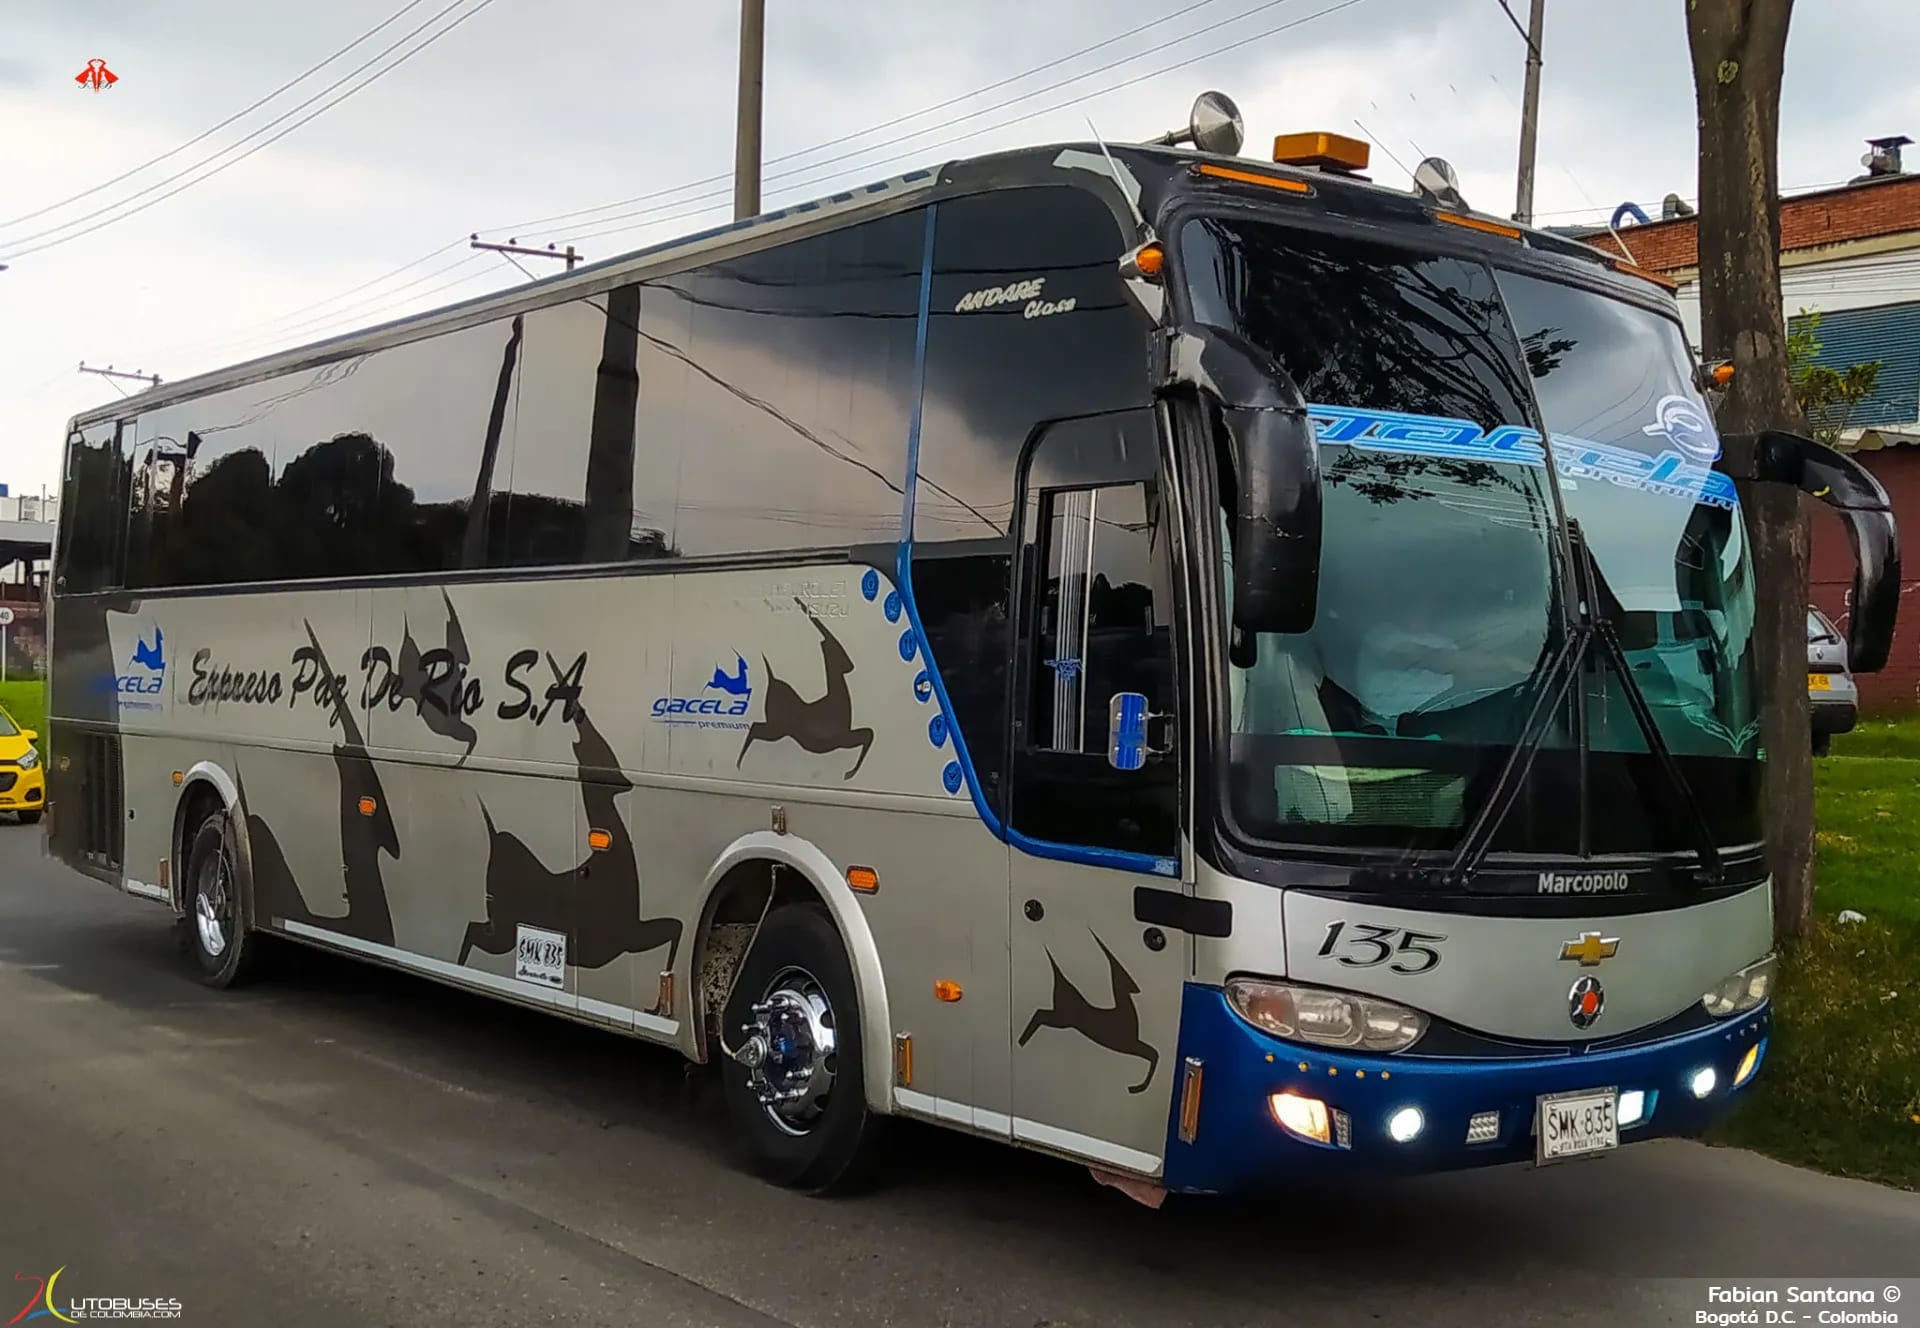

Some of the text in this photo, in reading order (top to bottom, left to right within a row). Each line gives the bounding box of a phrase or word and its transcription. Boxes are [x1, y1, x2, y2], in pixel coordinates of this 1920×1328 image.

[955, 277, 1046, 313] ANDARE
[1024, 298, 1076, 319] Class
[697, 720, 750, 731] premium
[1537, 872, 1629, 893] Marcopolo
[1317, 919, 1448, 975] 135
[1548, 1101, 1614, 1141] SMK 835
